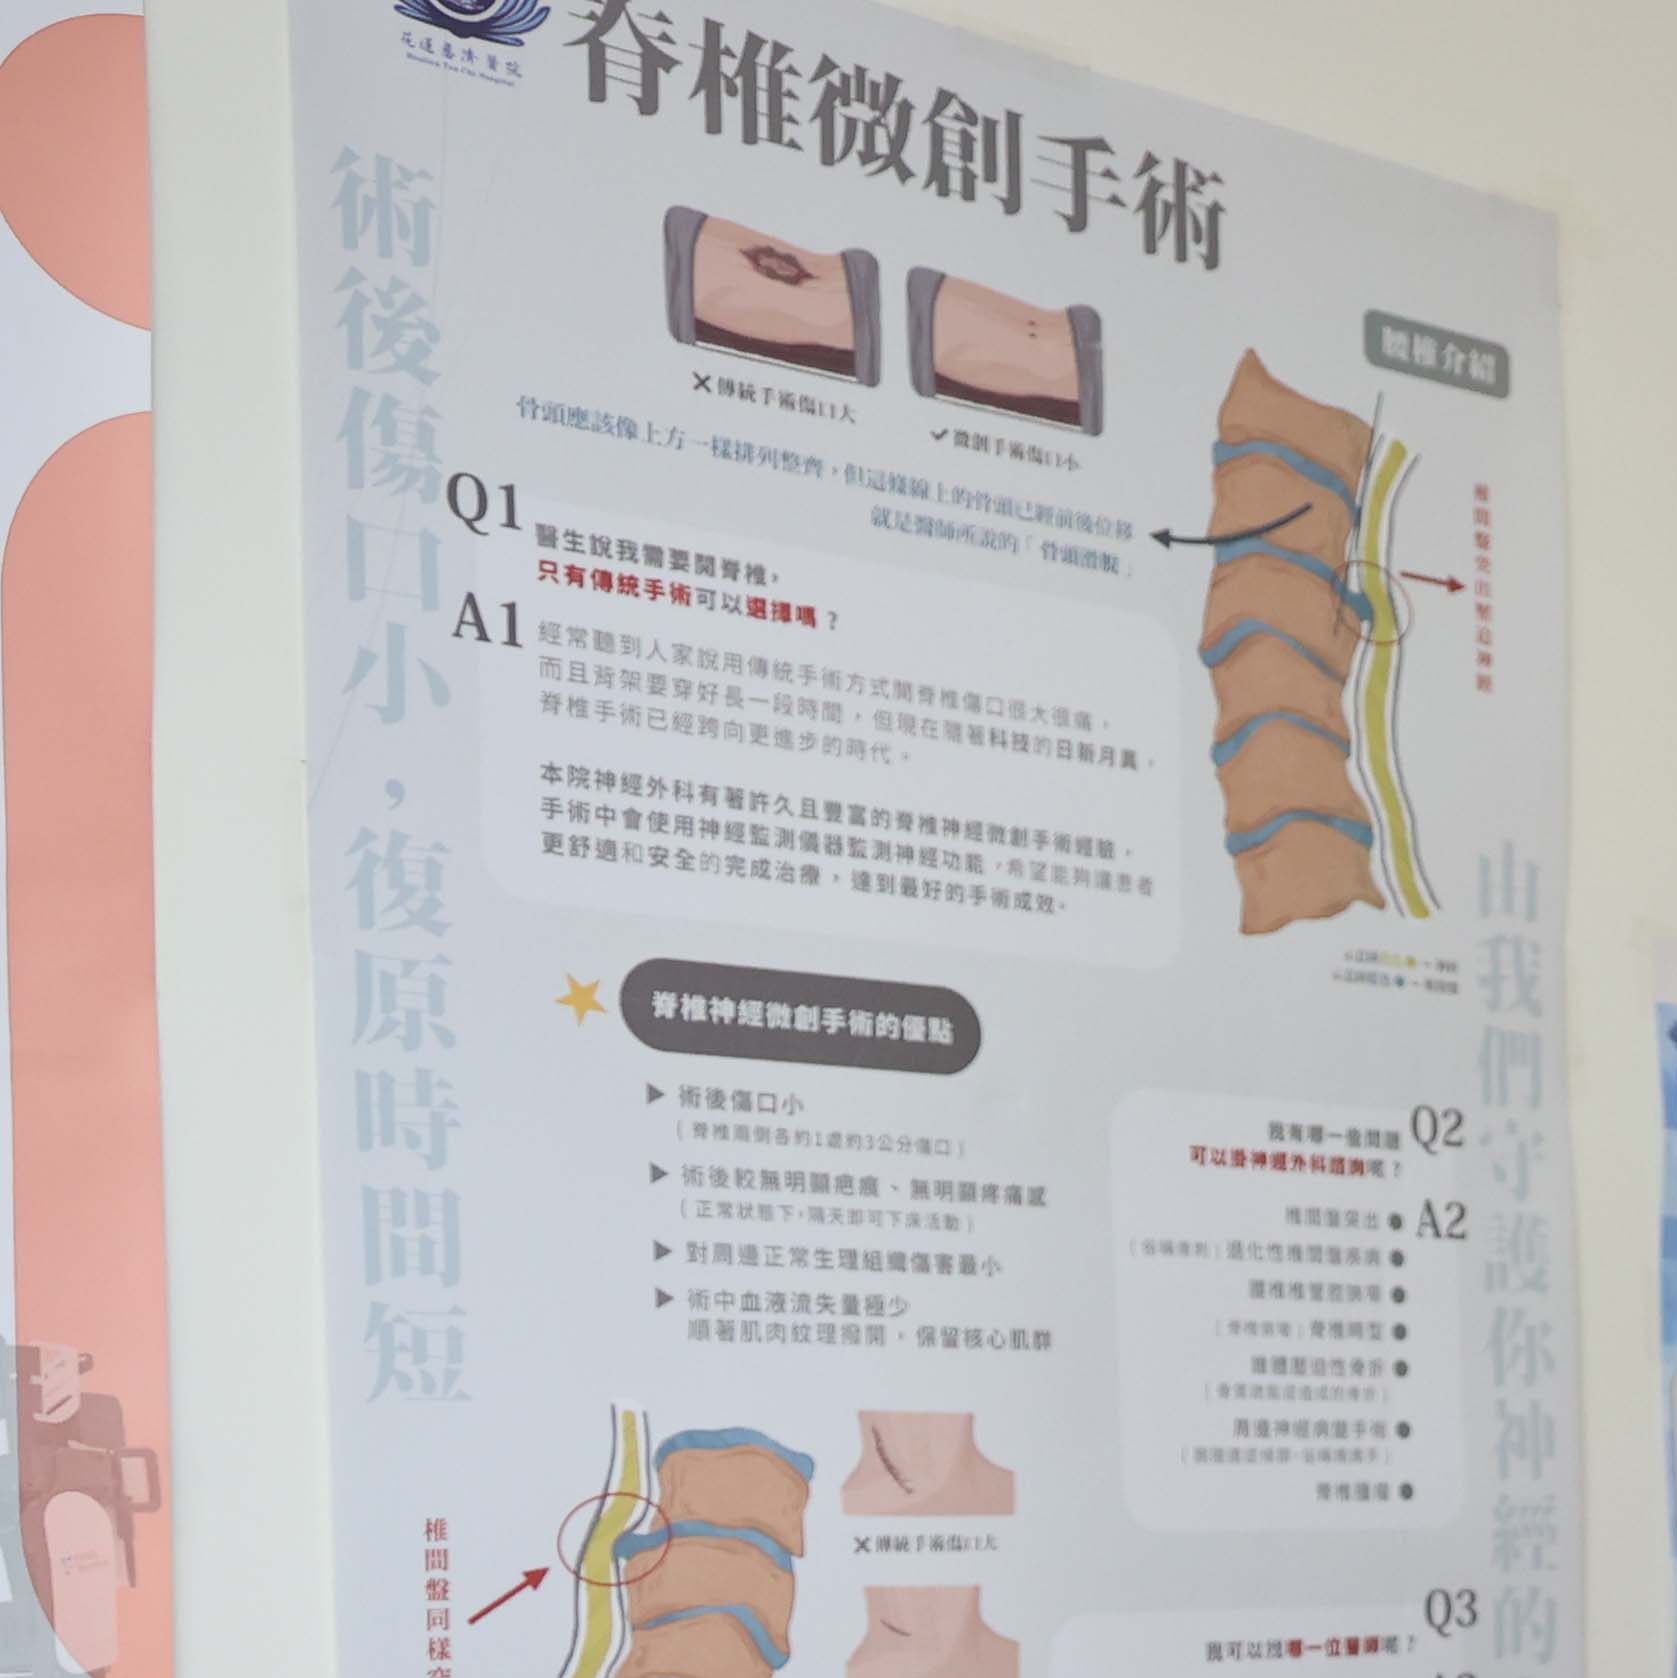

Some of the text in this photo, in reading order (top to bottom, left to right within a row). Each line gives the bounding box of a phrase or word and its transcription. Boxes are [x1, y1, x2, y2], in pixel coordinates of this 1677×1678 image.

[562, 0, 1228, 271] 脊椎微創手術
[446, 471, 522, 537] Q1
[451, 591, 523, 649] A1
[651, 989, 956, 1047] 脊椎神經微創手術的優點
[677, 1085, 806, 1116] 術後傷口小
[1411, 1104, 1465, 1155] Q2
[1416, 1199, 1468, 1240] A2
[1425, 1588, 1480, 1638] Q3
